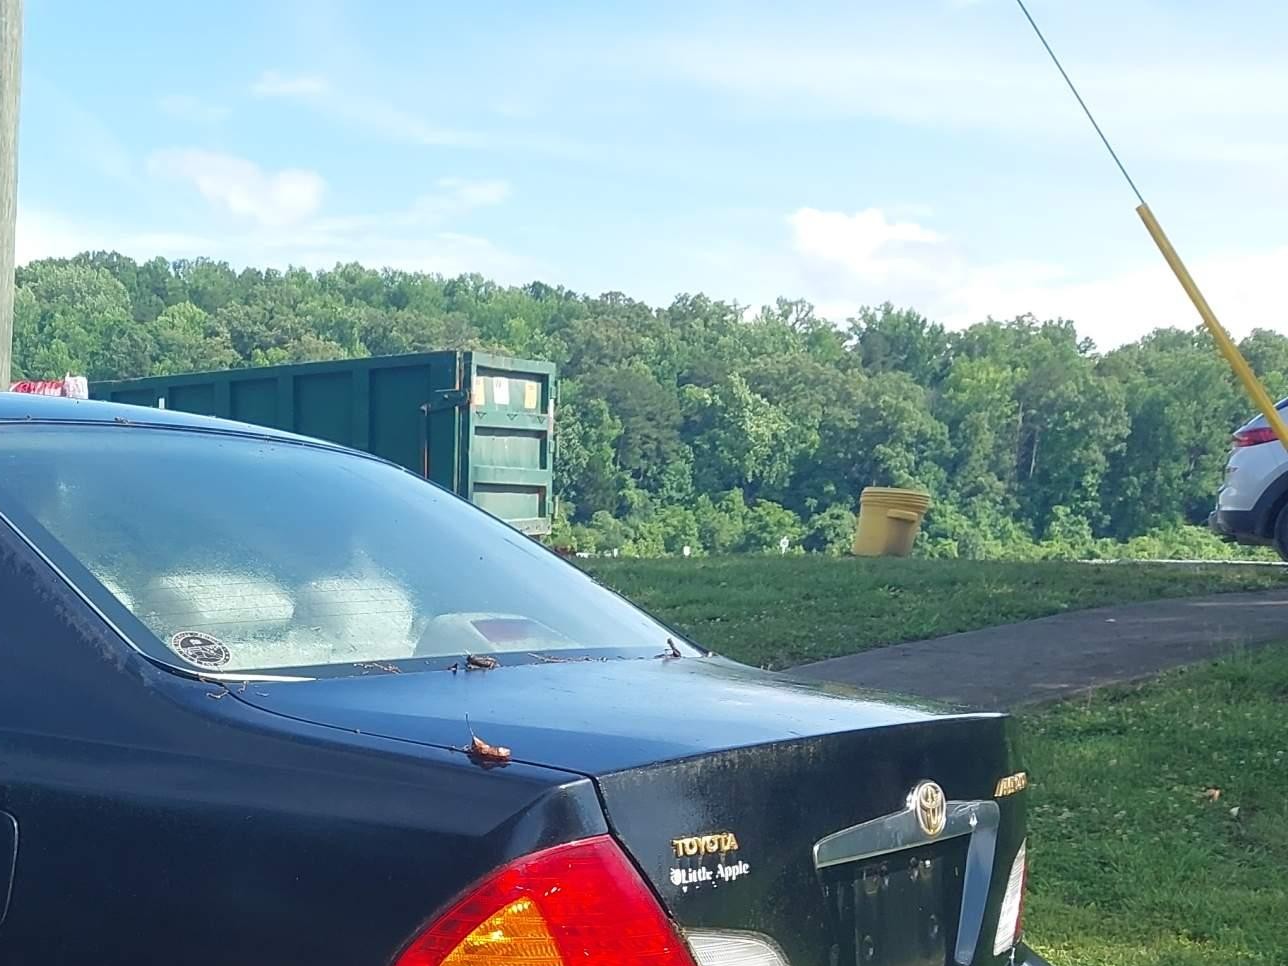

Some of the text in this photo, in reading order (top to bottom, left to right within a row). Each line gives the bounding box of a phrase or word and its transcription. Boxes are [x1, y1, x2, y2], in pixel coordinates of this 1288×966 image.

[672, 832, 739, 857] TOYOTA
[681, 860, 750, 884] Little Apple
